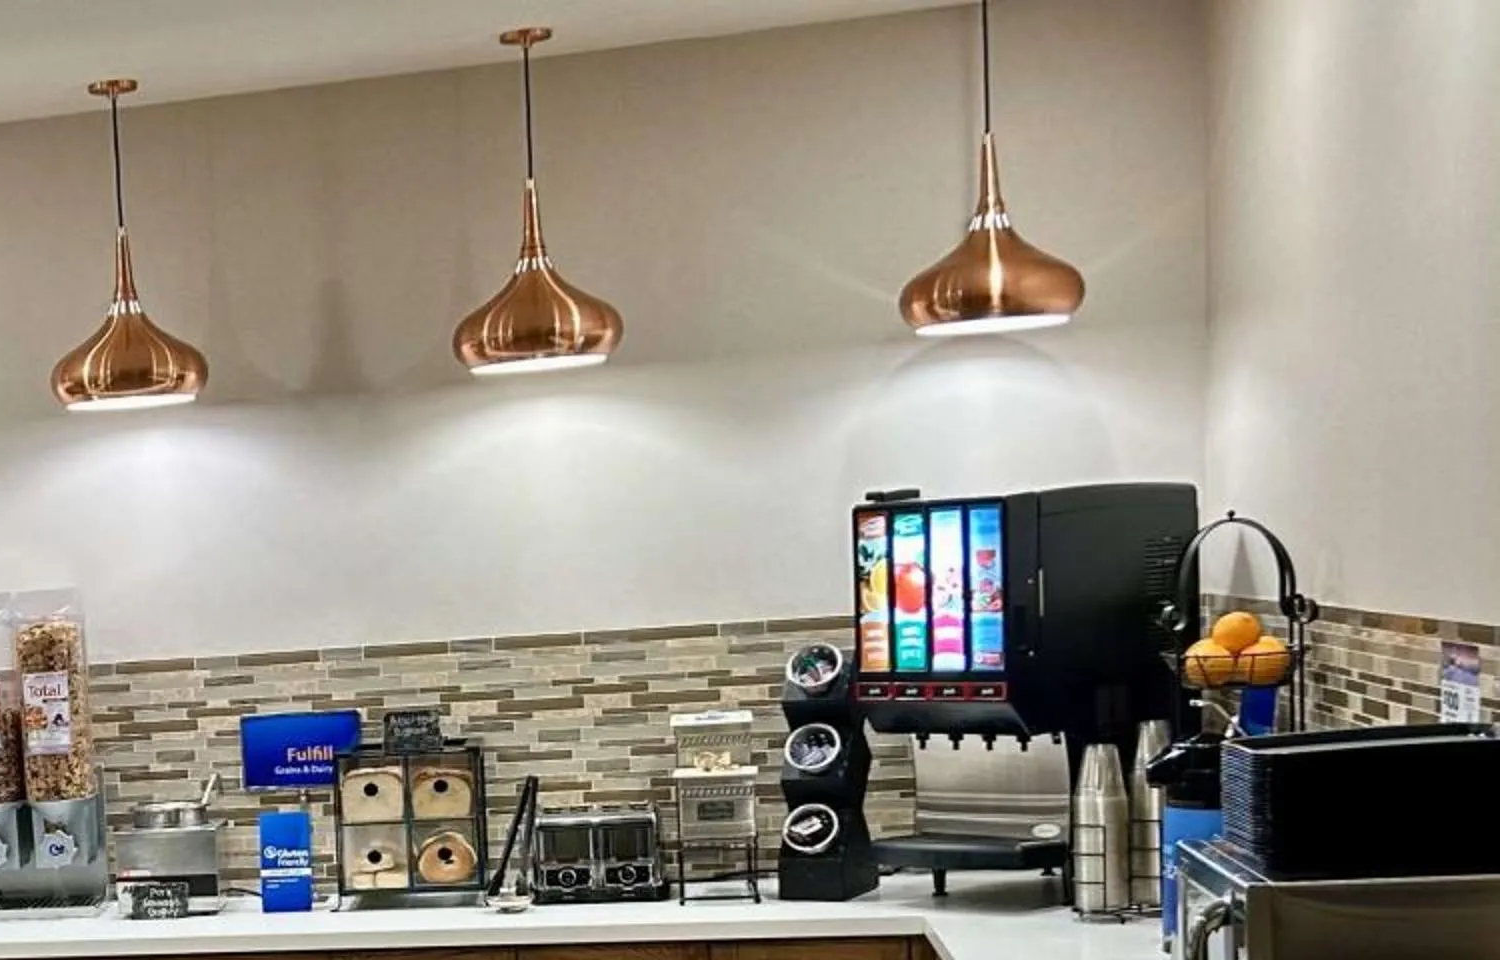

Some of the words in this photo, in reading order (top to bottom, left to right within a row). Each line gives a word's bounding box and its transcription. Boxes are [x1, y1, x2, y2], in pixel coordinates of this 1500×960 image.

[27, 683, 62, 698] Total
[286, 744, 334, 763] Fulfill
[274, 765, 301, 775] Grains
[303, 764, 310, 774] &
[311, 763, 334, 775] Dairy
[277, 848, 309, 858] Gluten
